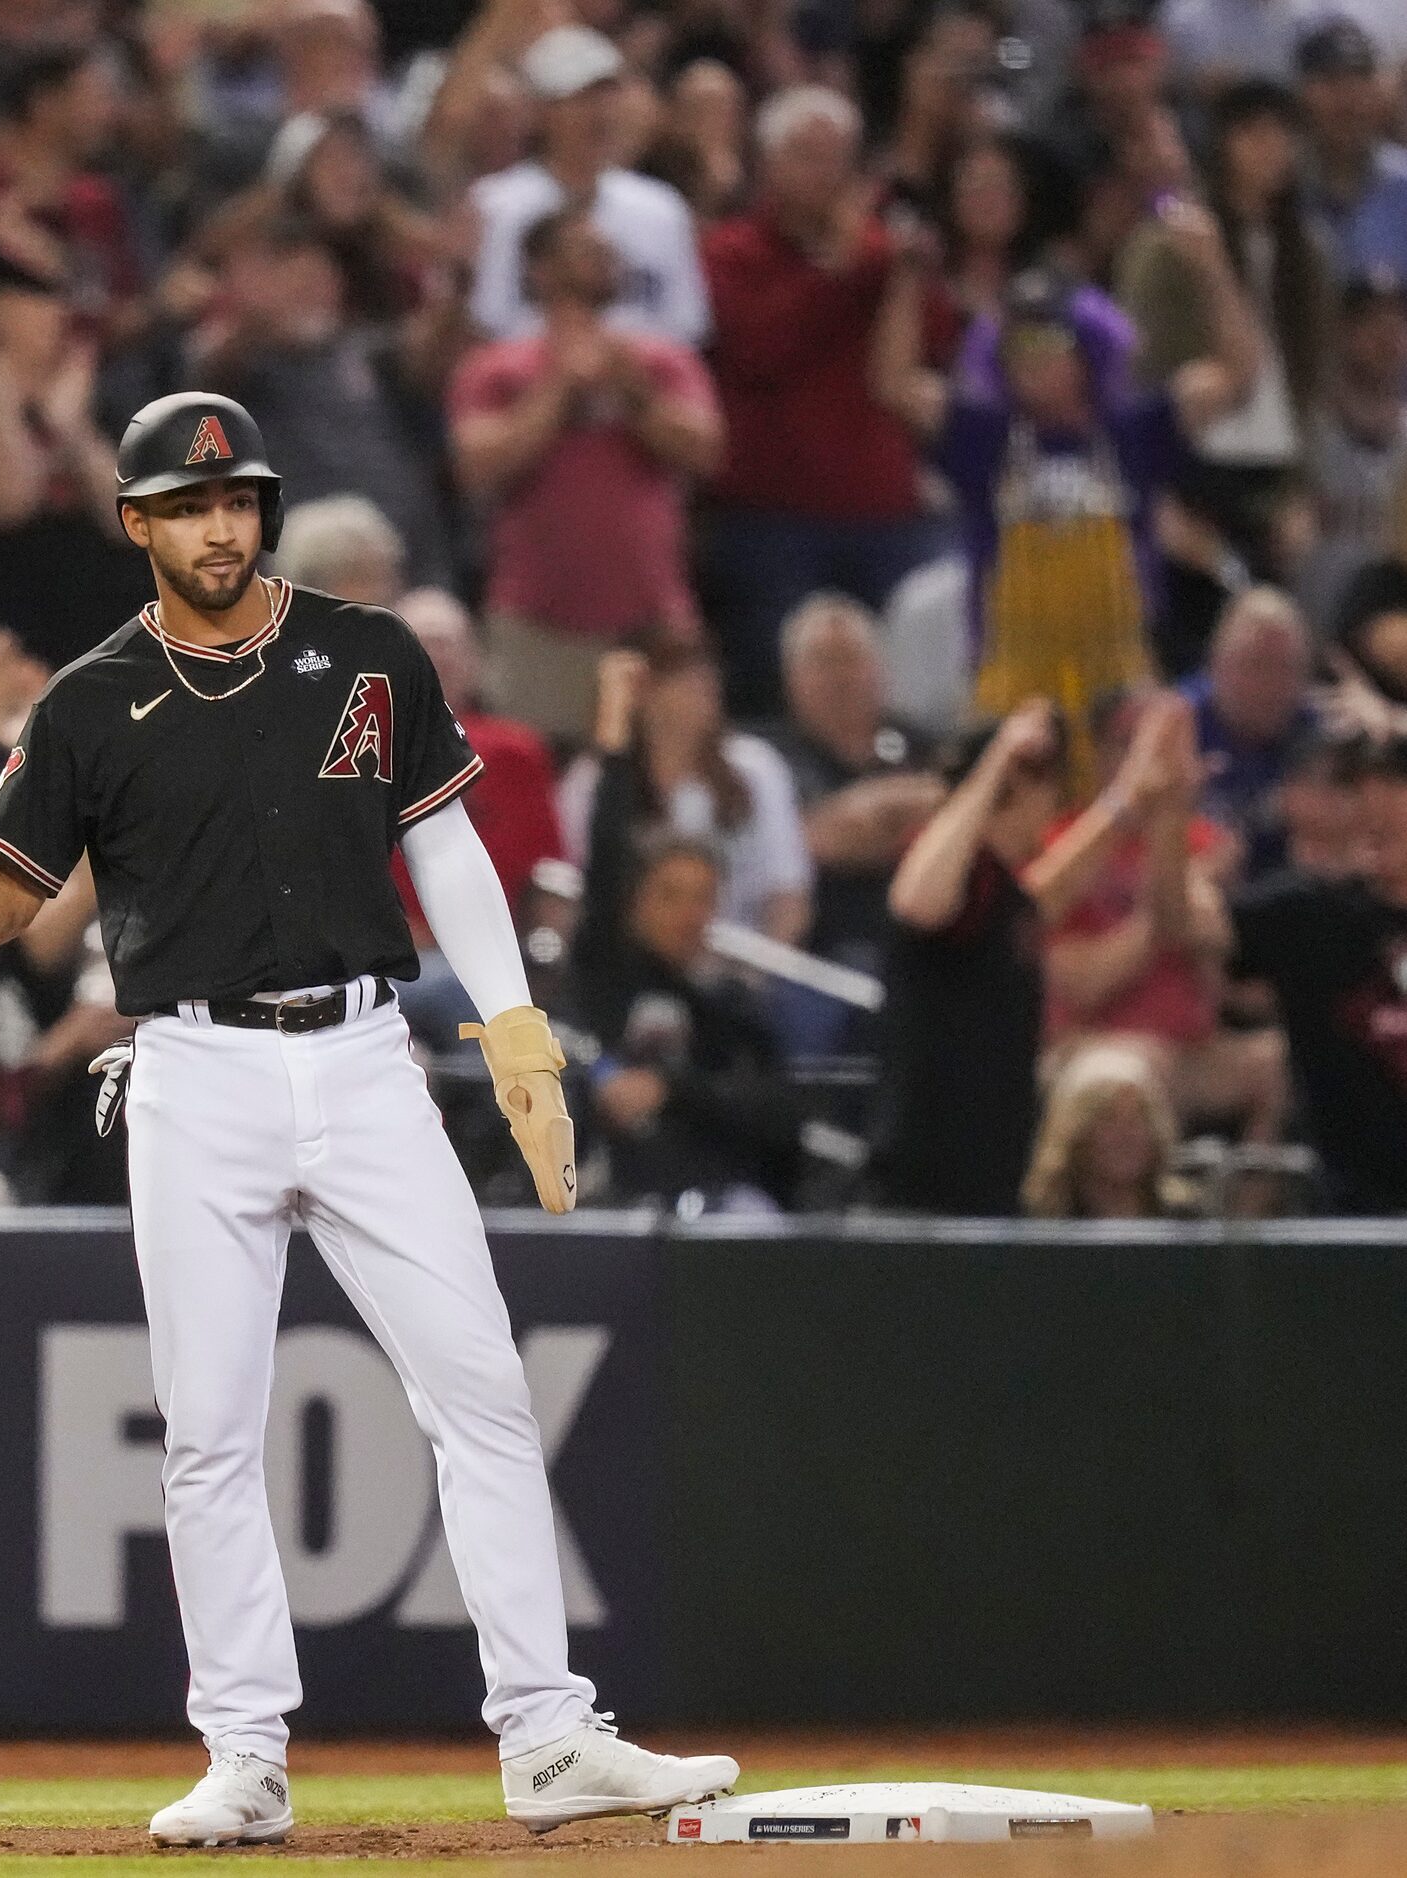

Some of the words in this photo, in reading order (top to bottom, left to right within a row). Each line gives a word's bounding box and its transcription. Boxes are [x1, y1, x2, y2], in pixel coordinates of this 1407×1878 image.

[294, 654, 330, 666] WORLD
[296, 661, 332, 674] SERIES
[39, 1324, 610, 1628] FOX
[763, 1824, 790, 1833] WORLD
[789, 1824, 815, 1834] SERIES
